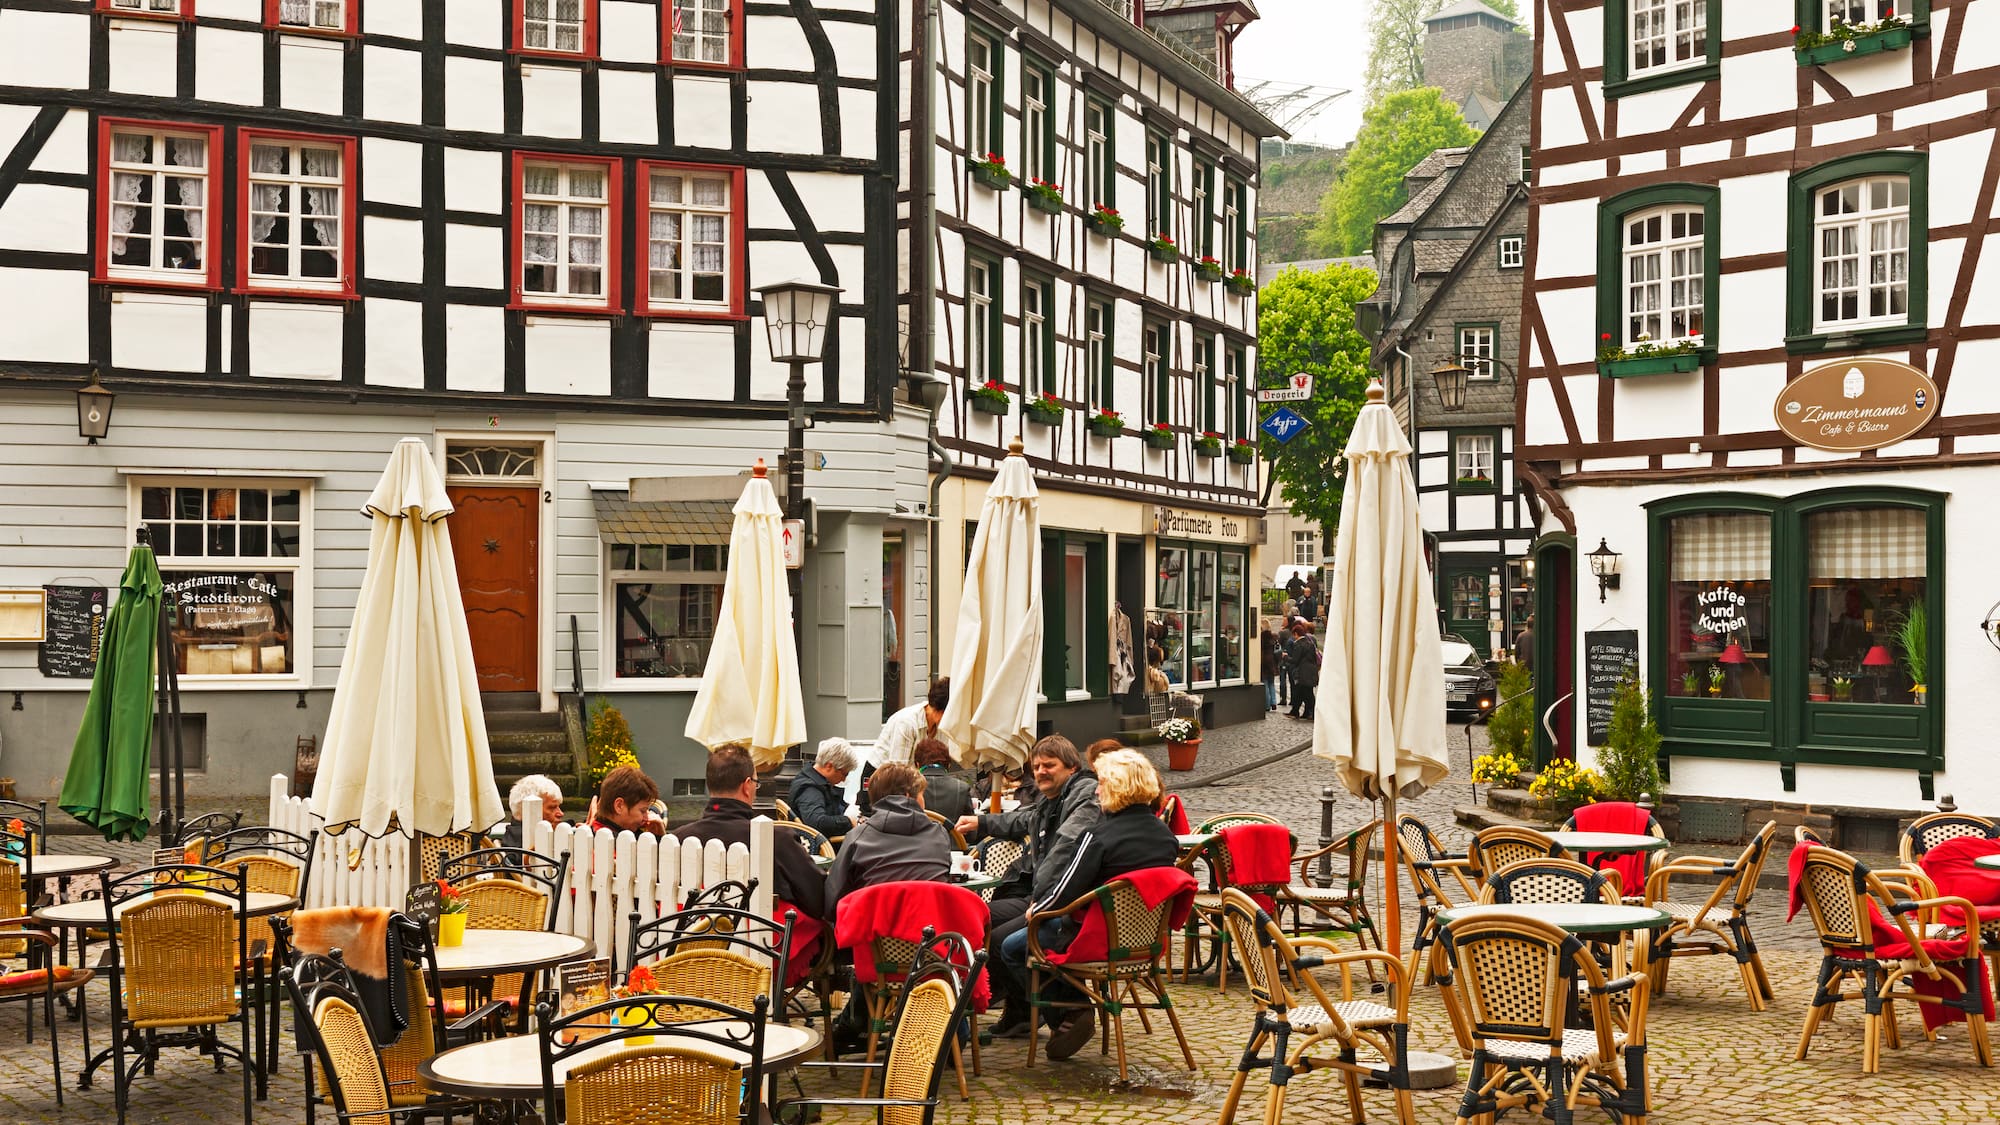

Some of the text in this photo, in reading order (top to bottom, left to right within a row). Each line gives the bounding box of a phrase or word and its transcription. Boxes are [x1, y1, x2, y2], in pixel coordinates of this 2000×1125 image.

[1264, 389, 1305, 400] Drogerie
[1801, 404, 1908, 424] Zimmermanns
[1266, 416, 1298, 436] Agfa
[1820, 420, 1889, 436] Café & Bistro
[544, 491, 552, 503] 2
[1167, 509, 1238, 537] Parfümerie Foto
[164, 575, 238, 594] Restaurant
[247, 577, 278, 597] Café
[1697, 586, 1746, 606] Kaffee
[178, 592, 263, 606] Stadtkrone
[185, 605, 218, 614] (Parterre
[1711, 603, 1734, 618] und
[1698, 613, 1747, 634] Kuchen
[90, 613, 101, 662] WARSTEINER
